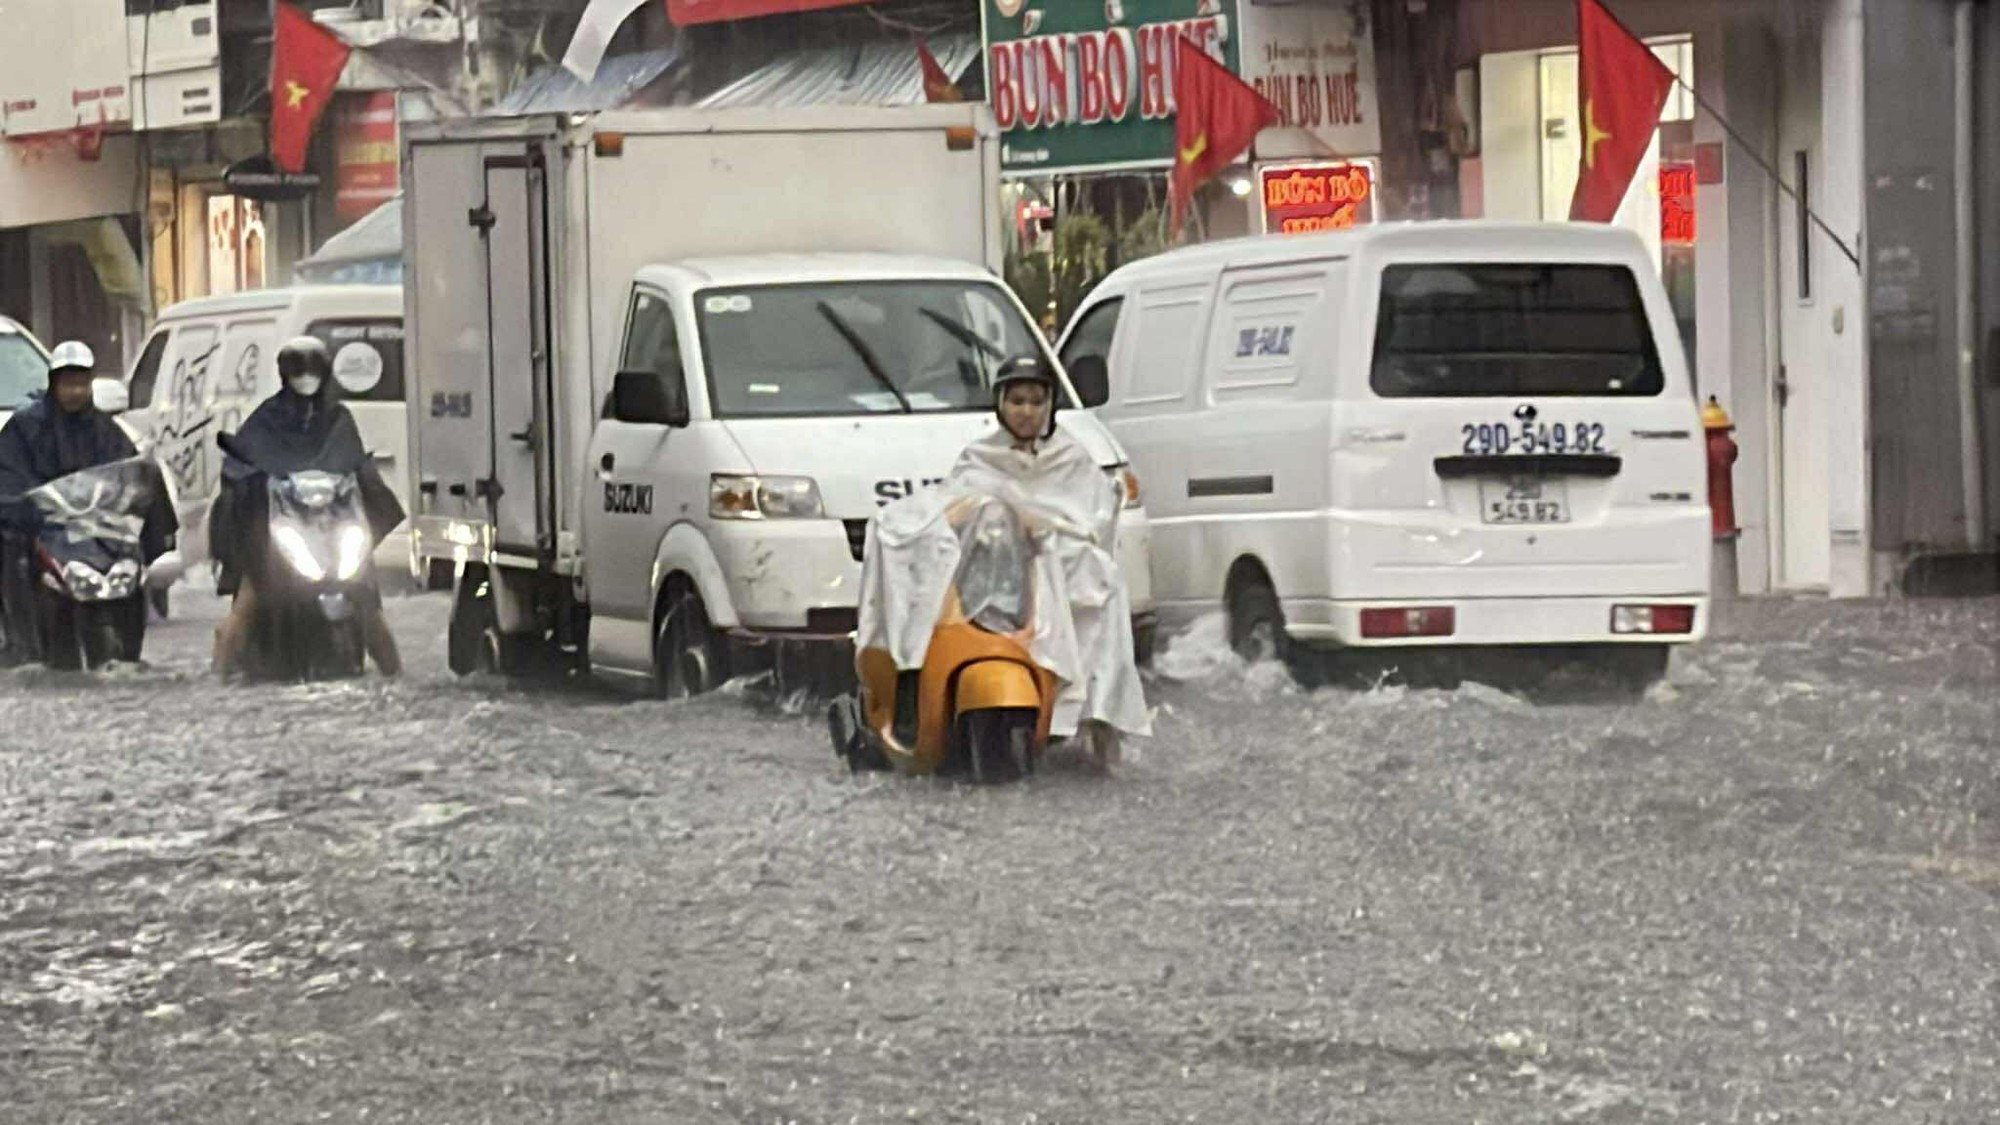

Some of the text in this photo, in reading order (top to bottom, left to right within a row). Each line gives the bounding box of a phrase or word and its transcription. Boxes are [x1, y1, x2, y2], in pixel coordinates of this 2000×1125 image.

[990, 10, 1068, 131] BÚN
[1077, 0, 1131, 124] BÒ
[1462, 422, 1605, 454] 29D-549.82
[604, 482, 653, 515] SUZUKI
